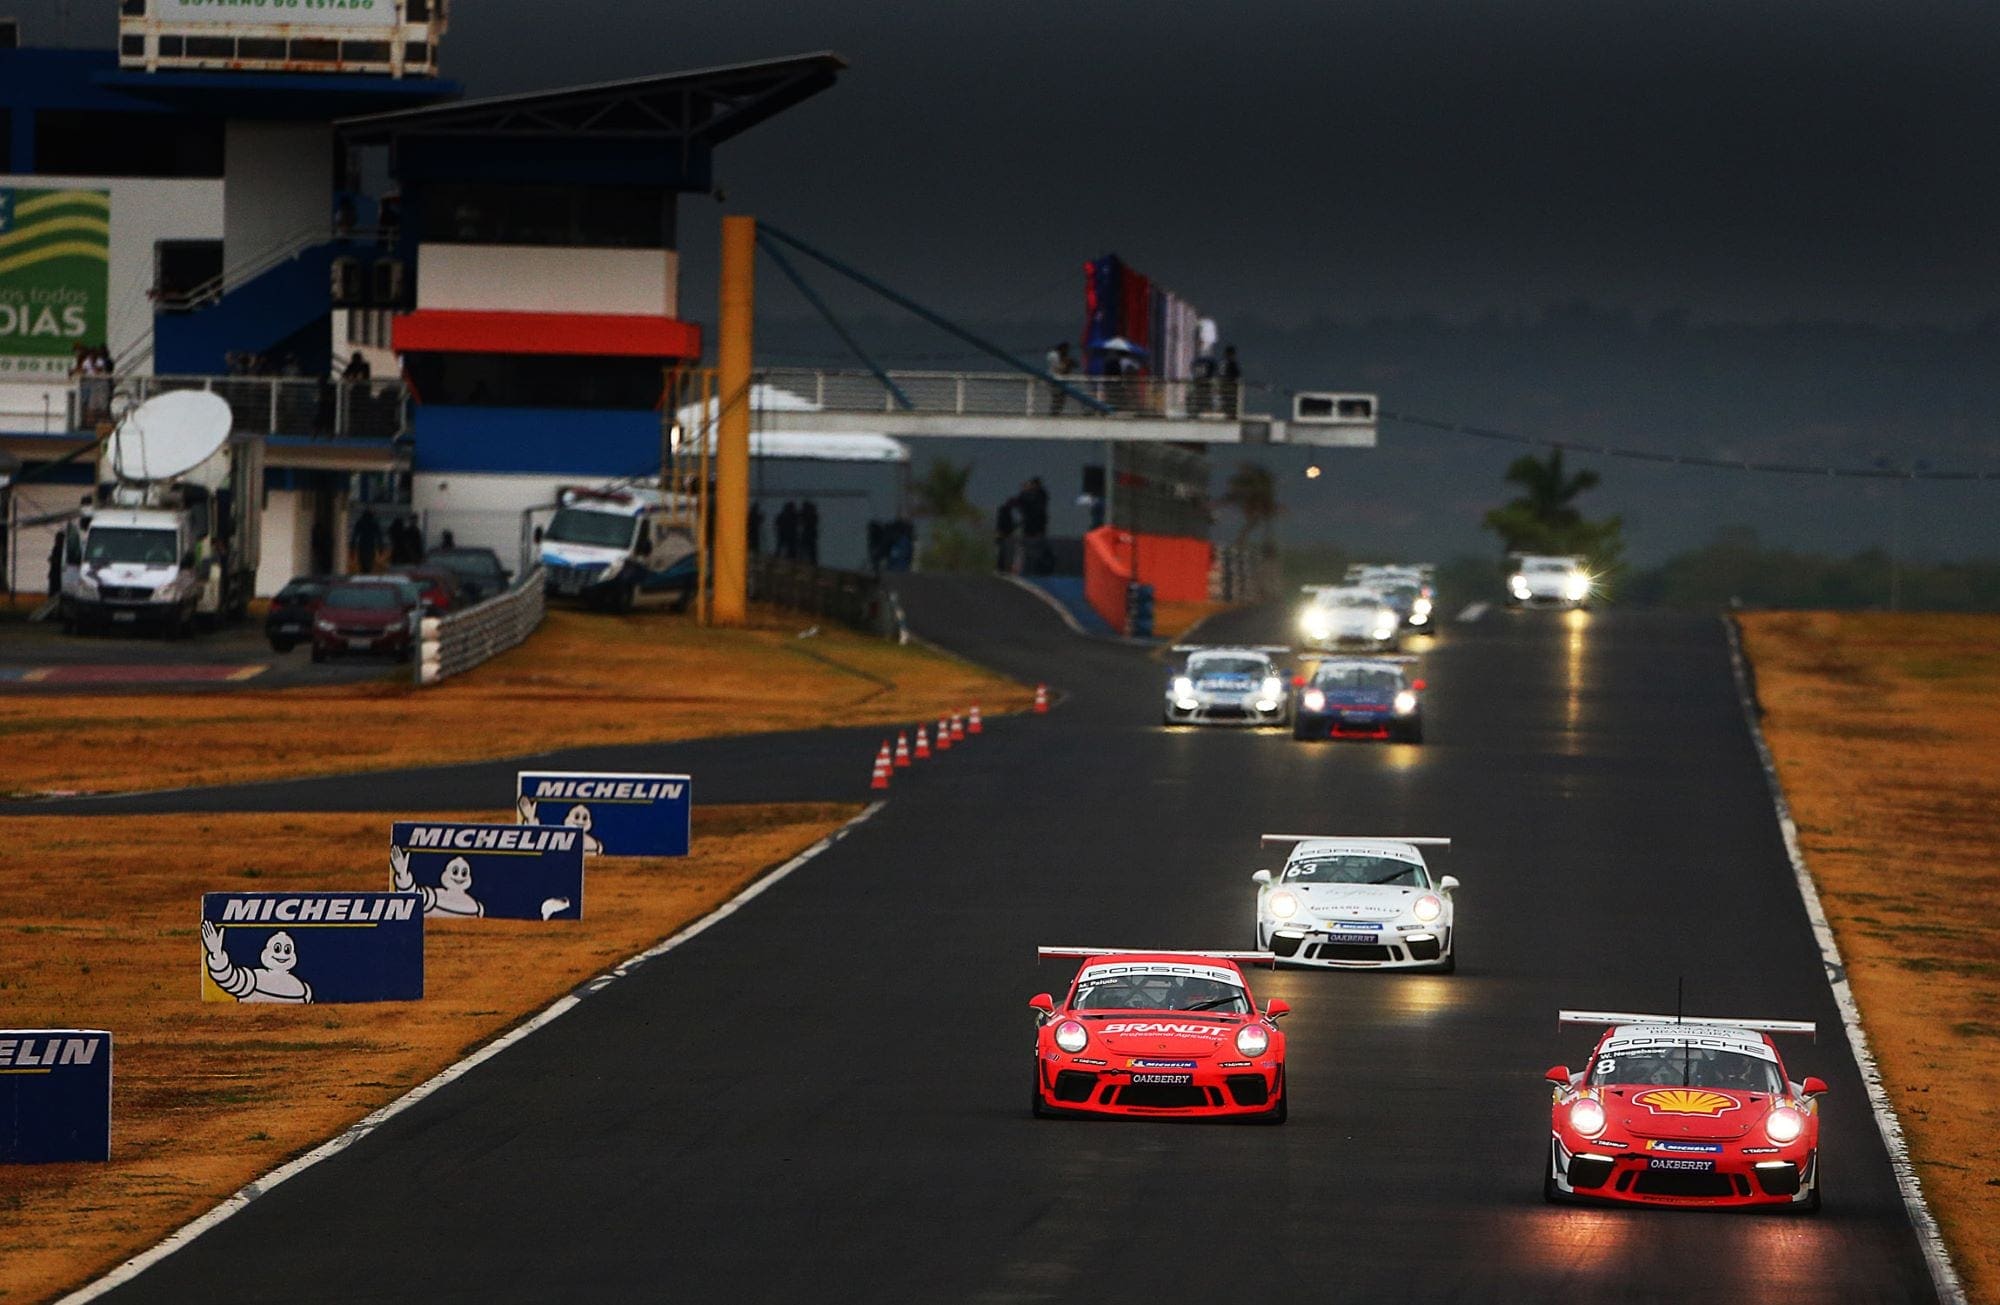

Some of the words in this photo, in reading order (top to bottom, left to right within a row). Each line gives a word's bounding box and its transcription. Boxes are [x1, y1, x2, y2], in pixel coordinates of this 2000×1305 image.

[535, 781, 684, 800] MICHELIN
[408, 827, 577, 851] MICHELIN
[1286, 863, 1318, 878] 63
[222, 898, 416, 921] MICHELIN
[1329, 933, 1376, 943] OAKBERRY
[1088, 966, 1231, 981] PORSCHE
[1077, 986, 1096, 1002] 7
[1098, 1023, 1232, 1037] BRANDT
[0, 1038, 100, 1066] ELIN
[1608, 1037, 1766, 1056] PORSCHE
[1596, 1059, 1616, 1075] 8
[1132, 1074, 1190, 1085] OAKBERRY
[1650, 1159, 1713, 1171] OAKBERRY
